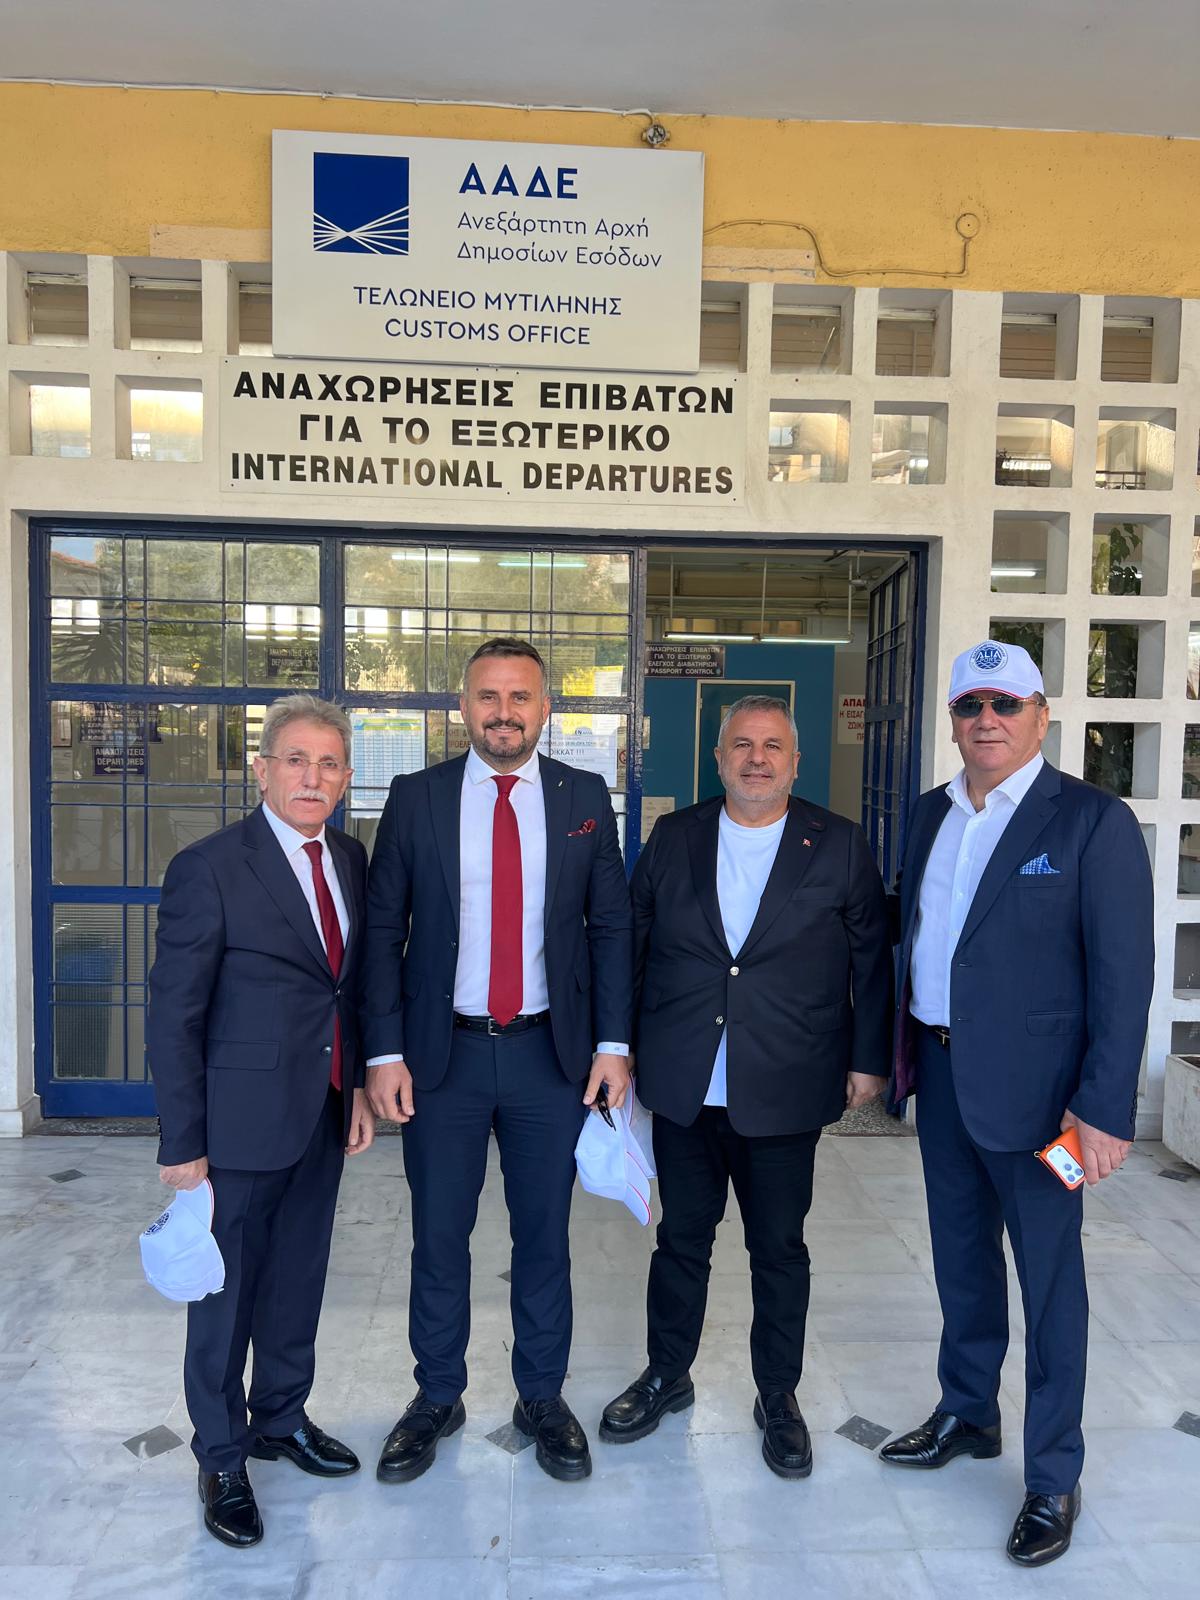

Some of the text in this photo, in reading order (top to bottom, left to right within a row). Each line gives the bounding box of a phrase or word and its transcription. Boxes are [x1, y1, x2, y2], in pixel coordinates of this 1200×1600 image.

[458, 162, 579, 200] ΑΑΔΕ
[457, 210, 650, 241] Ανεξάρτητη Αρχή
[457, 241, 663, 268] Δημοσίων Εσόδων
[353, 286, 622, 316] ΤΕΛΩΝΕΙΟ ΜΥΤΙΛΗΝΗΣ
[385, 318, 590, 345] CUSTOMS OFFICE
[233, 371, 733, 414] ΑΝΑΧΩΡΗΣΕΙΣ ΕΠΙΒΑΤΩΝ
[299, 413, 669, 453] ΓΙΑ ΤΟ ΕΞΩΤΕΡΙΚΟ
[231, 452, 732, 495] INTERNATIONAL DEPARTURES
